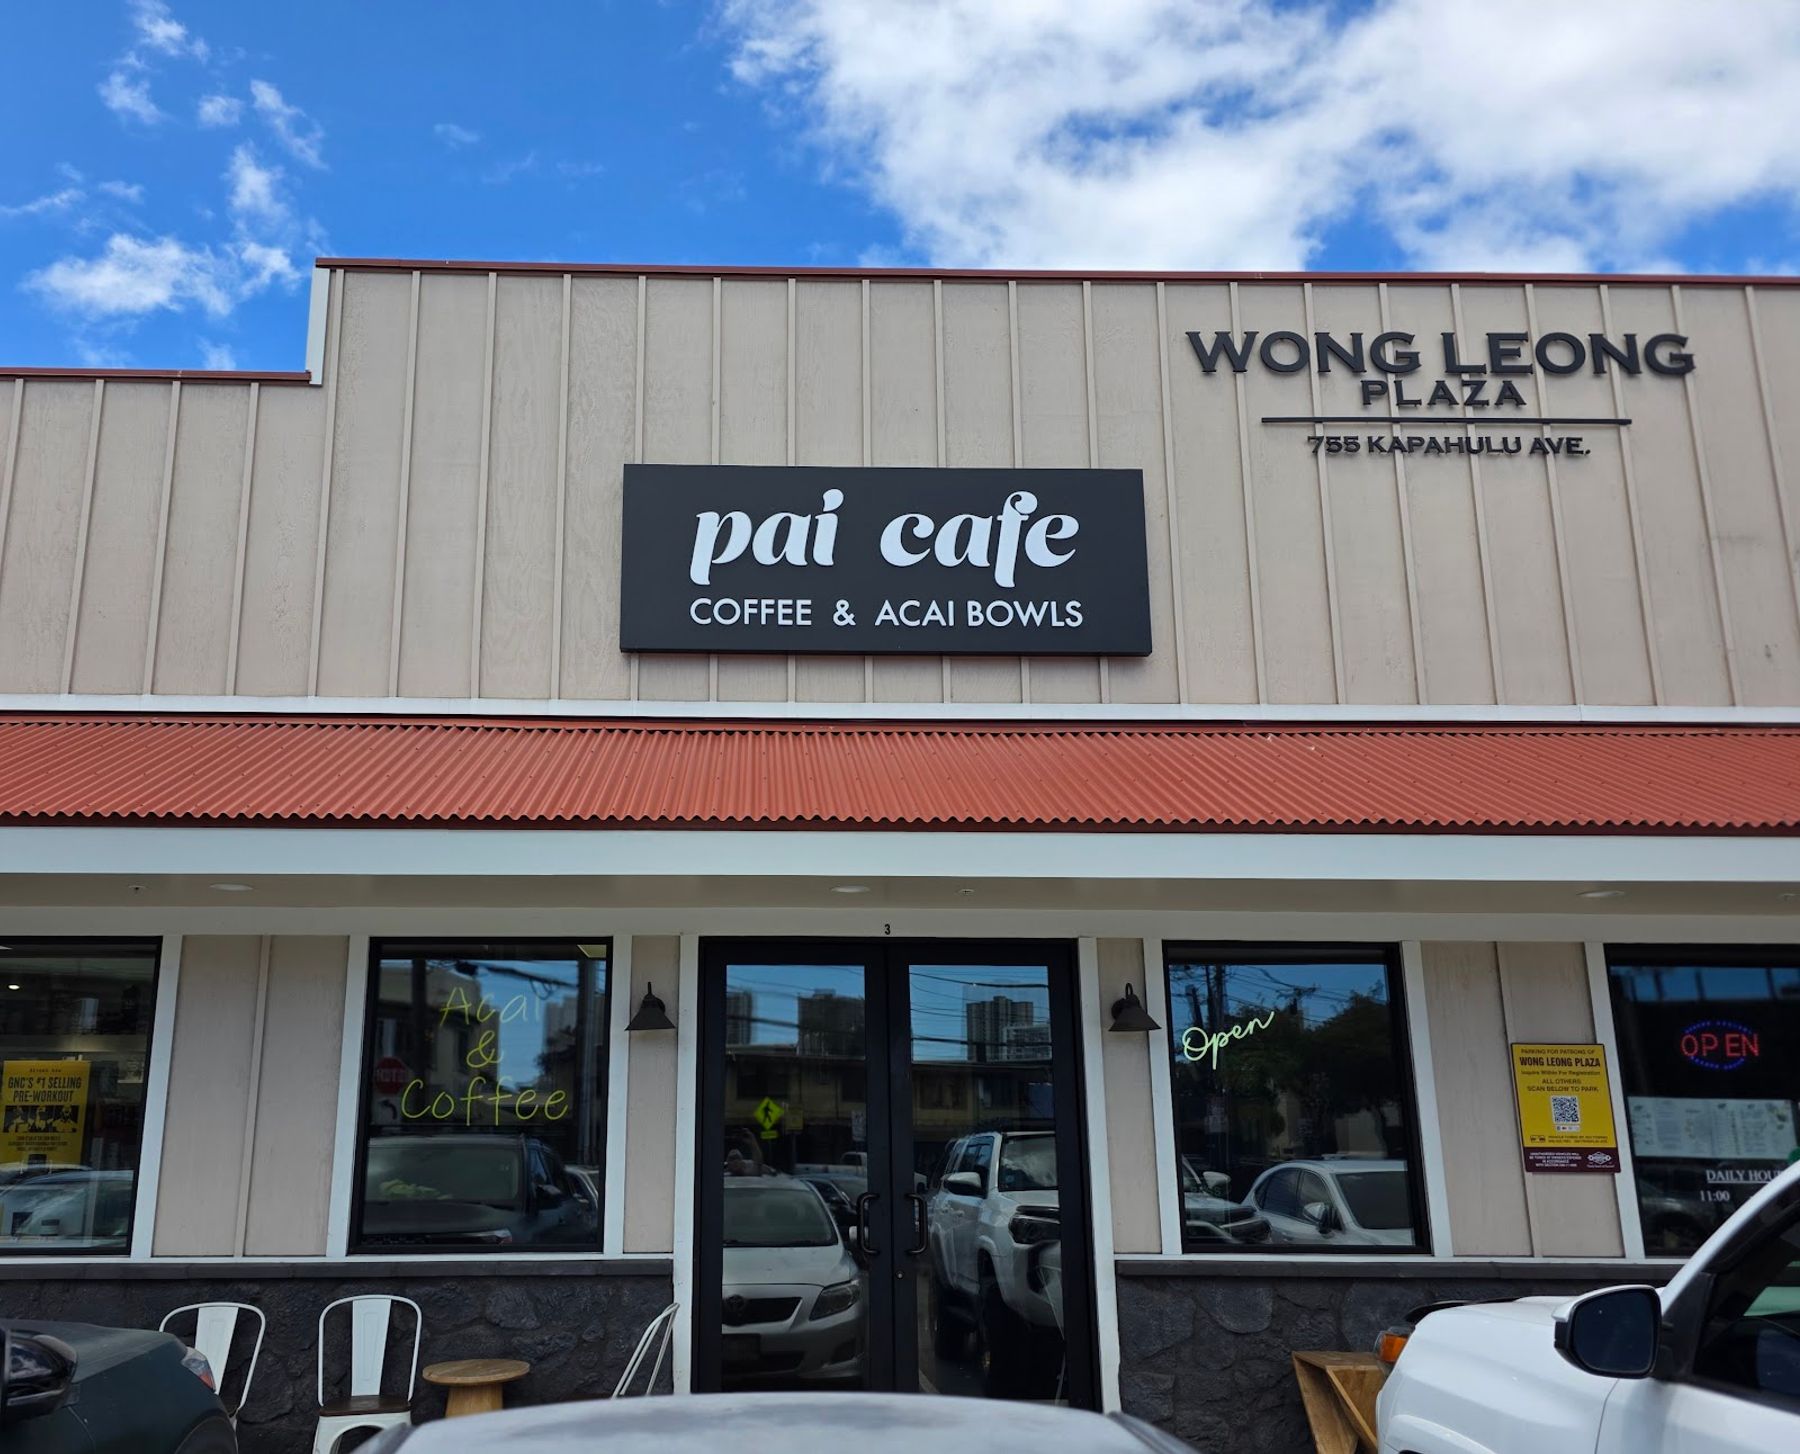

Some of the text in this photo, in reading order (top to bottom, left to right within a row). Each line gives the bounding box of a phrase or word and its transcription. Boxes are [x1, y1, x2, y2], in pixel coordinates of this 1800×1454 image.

[1186, 331, 1696, 376] WONG LEONG
[1361, 380, 1527, 408] PLAZA
[1307, 435, 1592, 456] 755 KAPAHULU AVE.
[690, 488, 1080, 588] pai cafe
[690, 598, 1083, 628] COFFEE & ACAI BOWLS
[884, 923, 891, 935] 3
[440, 987, 540, 1026] Acai
[466, 1030, 504, 1068] &
[1181, 1010, 1275, 1070] Open
[1681, 1033, 1760, 1057] OPEN
[1519, 1057, 1600, 1067] WONG LEONG PLAZA
[48, 1077, 82, 1089] SELLING
[13, 1090, 74, 1103] PRE-WORKOUT
[400, 1075, 569, 1126] Coffee
[1706, 1169, 1746, 1182] DAILY
[1700, 1190, 1730, 1202] 11:00
